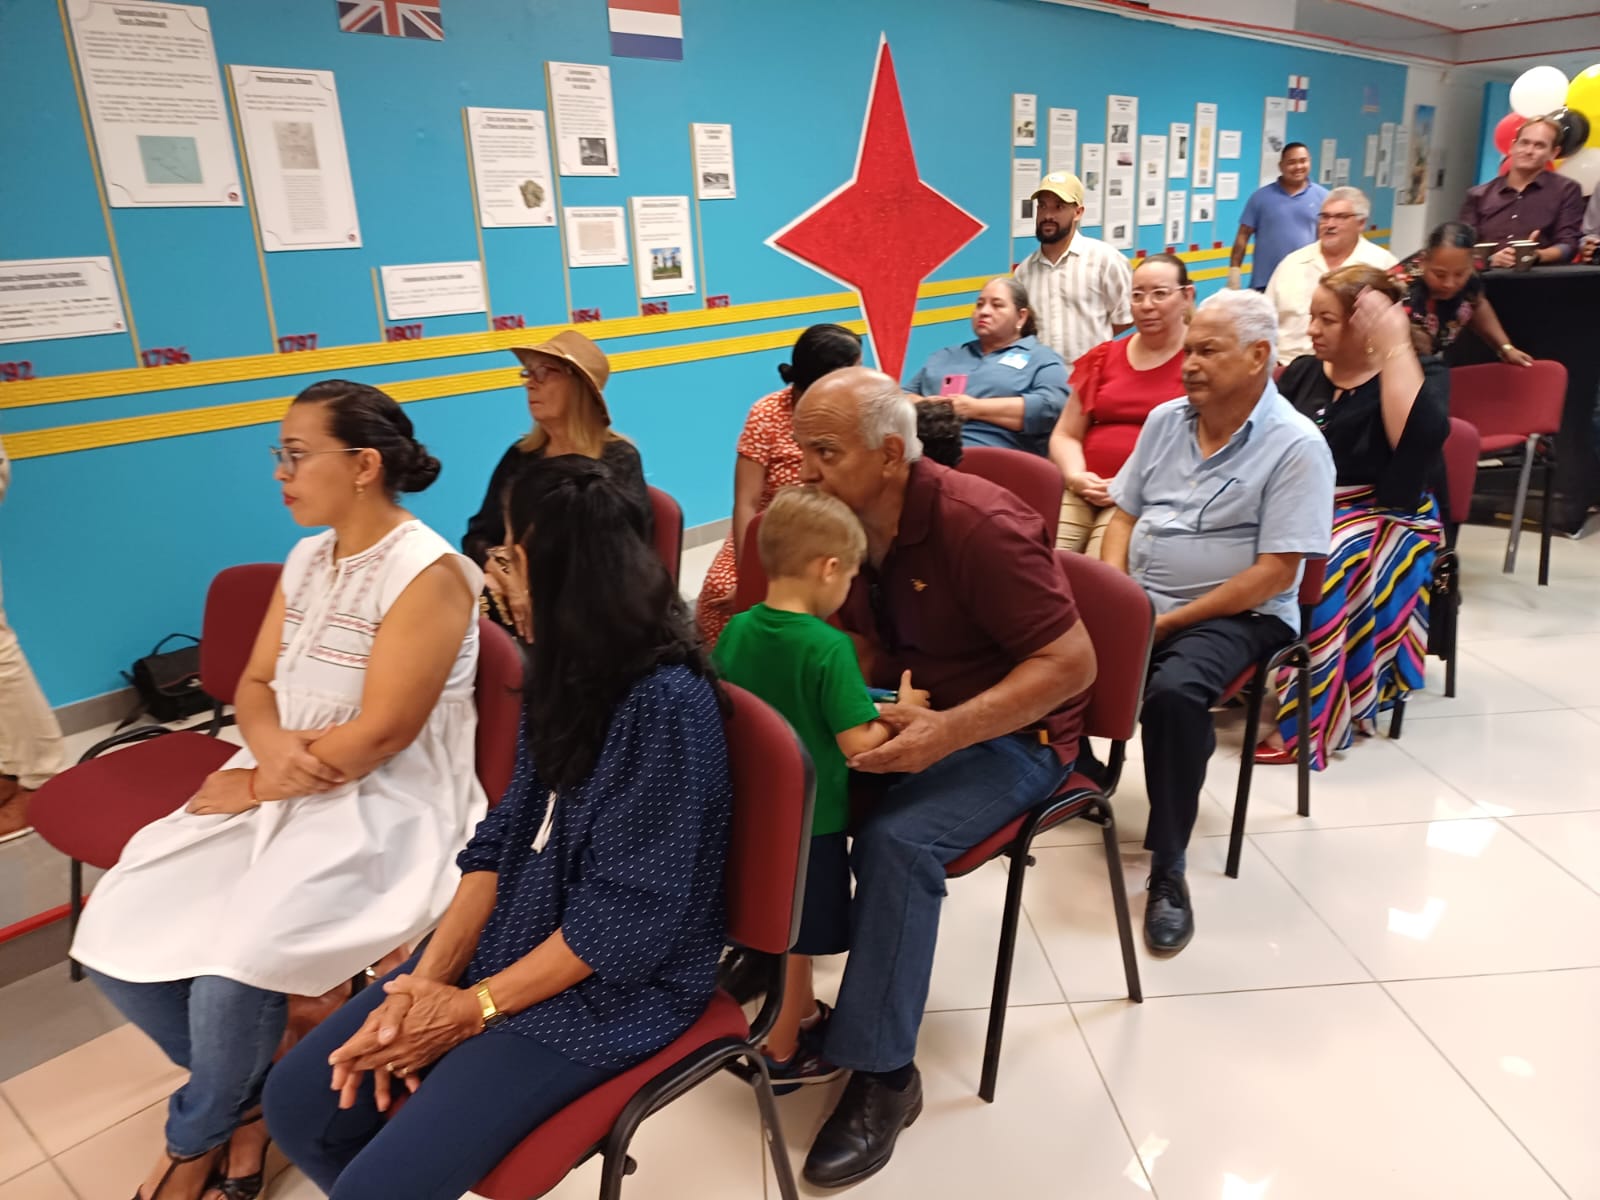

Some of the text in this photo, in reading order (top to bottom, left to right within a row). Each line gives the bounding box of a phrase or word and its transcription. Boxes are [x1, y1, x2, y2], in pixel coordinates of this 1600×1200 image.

[385, 323, 422, 342] 1807
[278, 333, 317, 353] 1797
[141, 346, 192, 368] 1796
